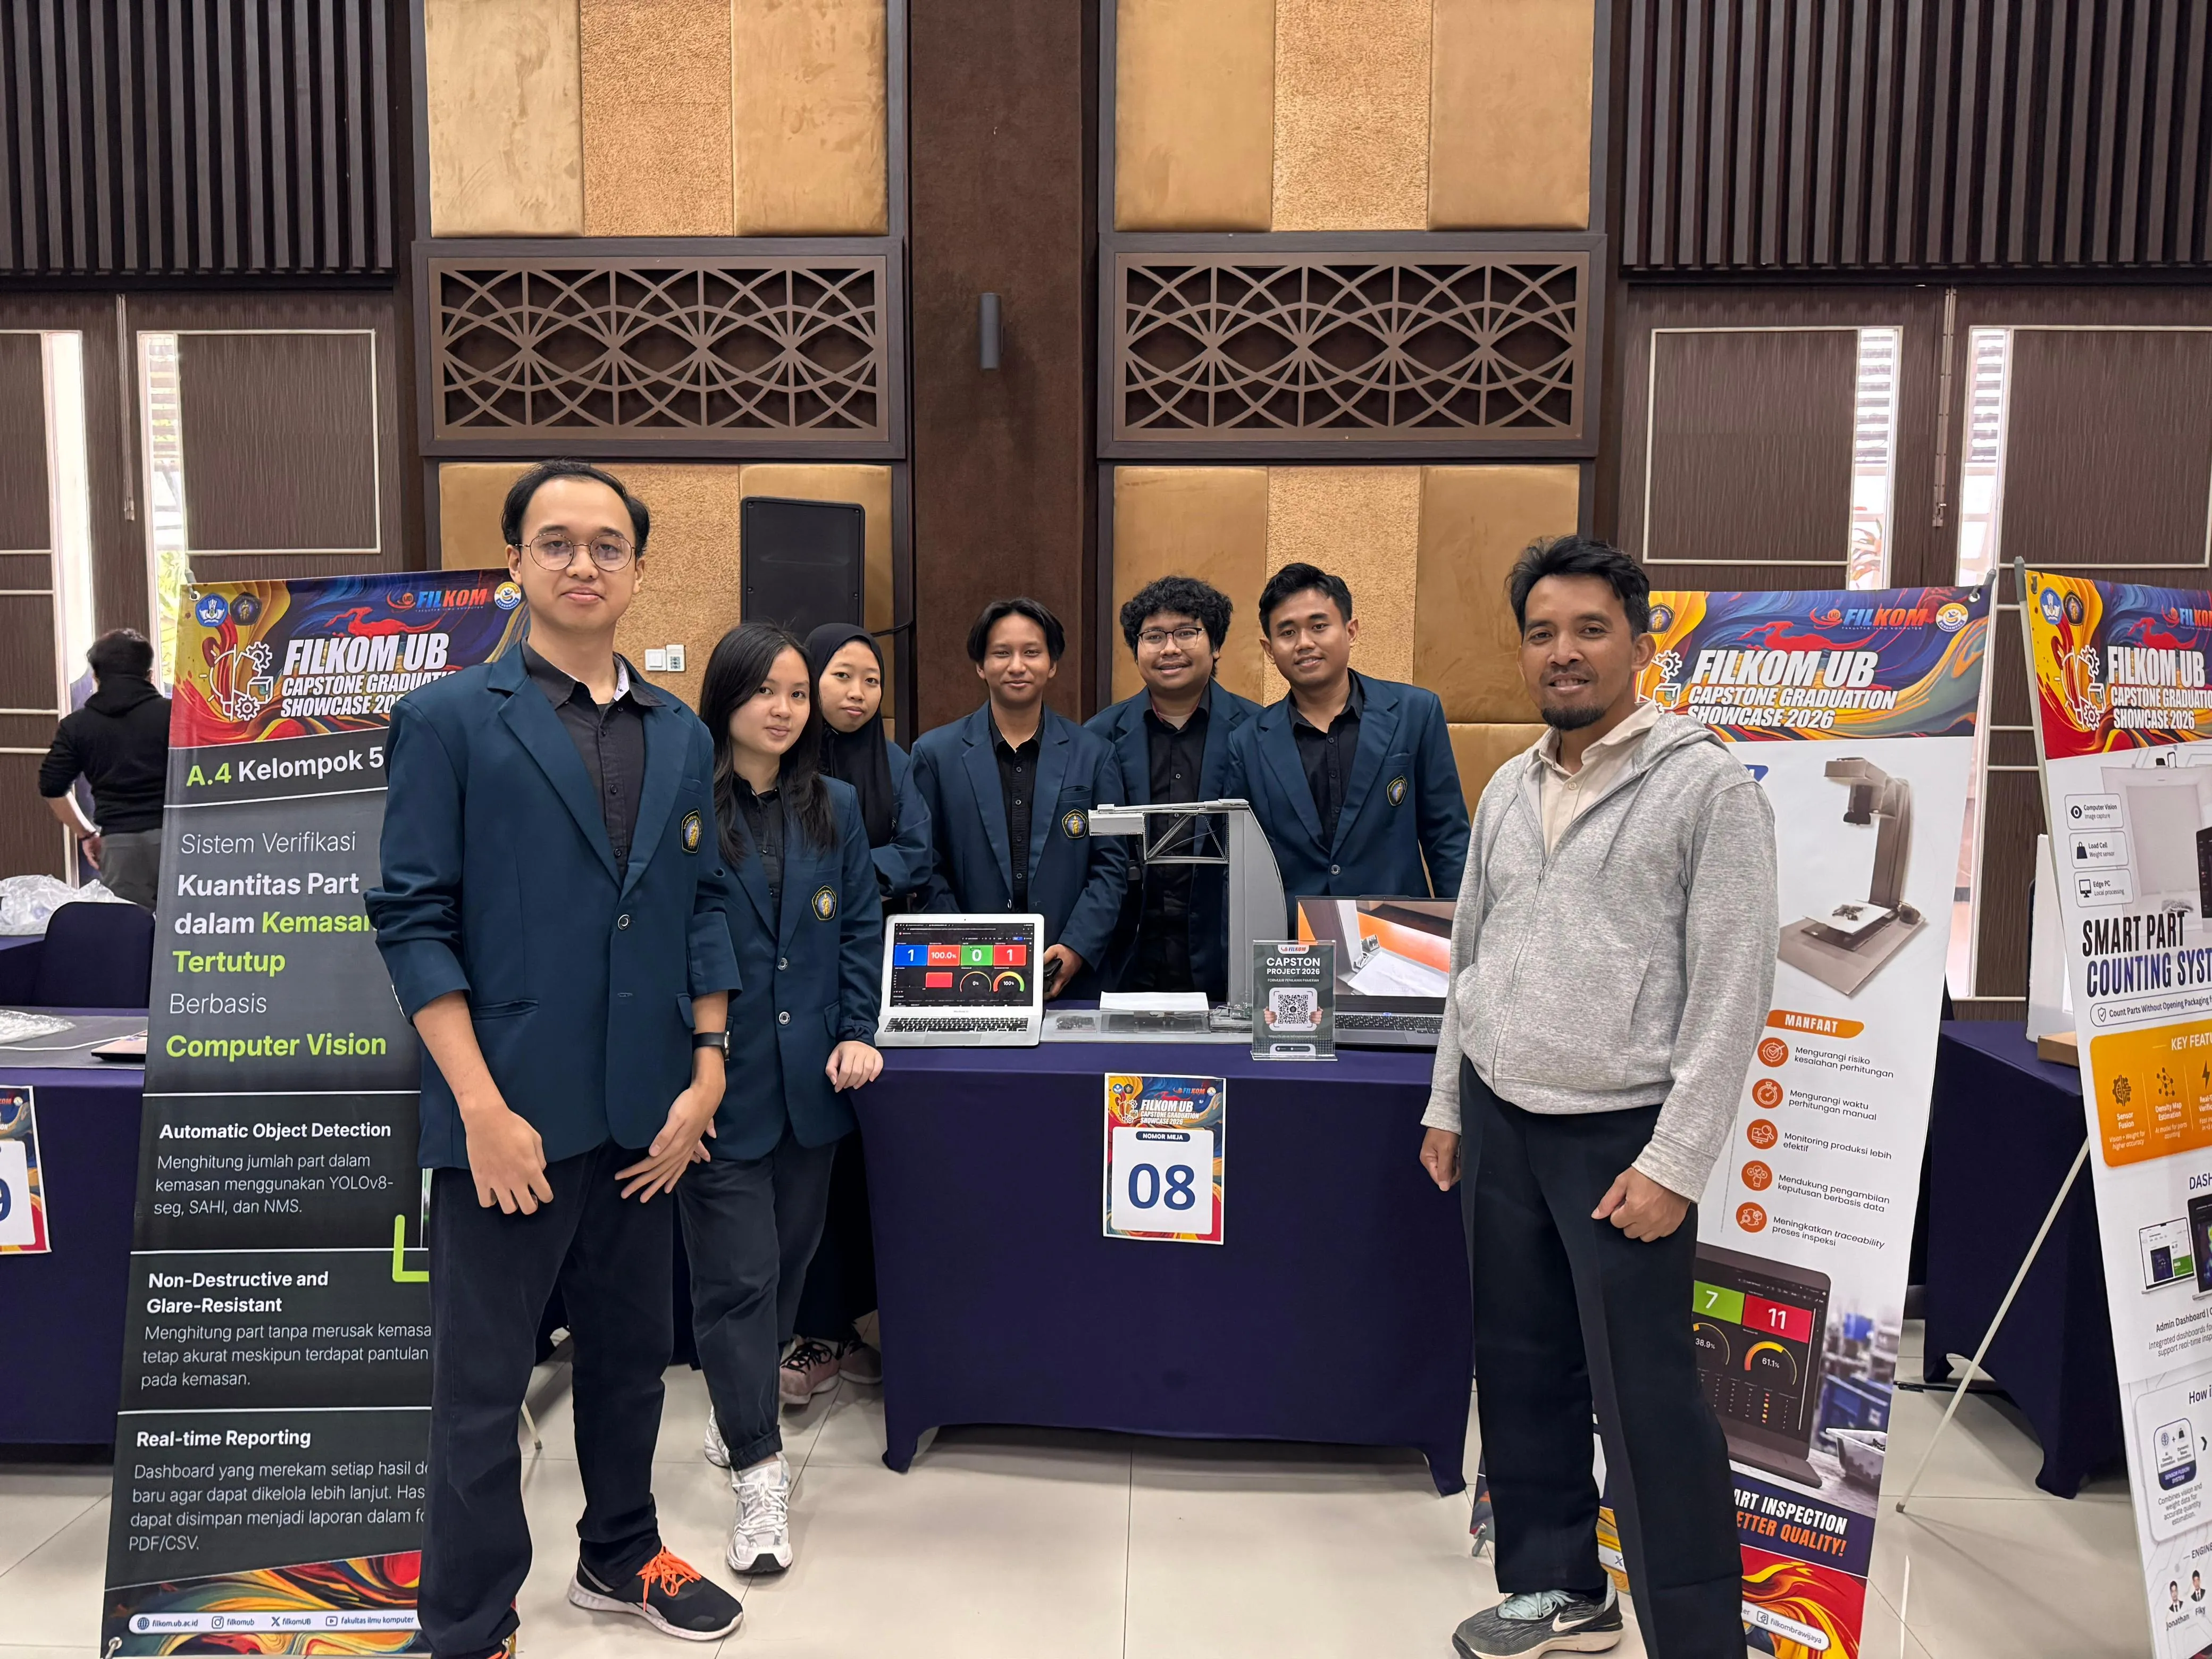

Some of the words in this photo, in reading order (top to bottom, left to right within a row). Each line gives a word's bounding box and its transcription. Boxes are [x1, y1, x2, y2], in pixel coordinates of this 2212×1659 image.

[416, 589, 488, 608] FILKOM
[1843, 608, 1928, 626] FILKOM
[283, 635, 399, 675] FILKOM
[402, 633, 449, 671] UB
[1691, 650, 1822, 686] FILKOM
[1824, 651, 1878, 688] UB
[2108, 646, 2176, 686] FILKOM
[2180, 651, 2205, 688] UB
[282, 674, 364, 697] CAPSTONE
[281, 697, 373, 717] SHOWCASE
[1688, 686, 1777, 706] CAPSTONE
[1779, 688, 1897, 709] GRADUATION
[2110, 686, 2161, 707] CAPSTONE
[1688, 706, 1784, 727] SHOWCASE
[1784, 709, 1836, 728] 2026
[2114, 708, 2169, 730] SHOWCASE
[2169, 710, 2194, 730] 2026
[186, 763, 231, 787] A.4
[239, 749, 363, 782] Kelompok
[369, 747, 384, 768] 5
[181, 834, 254, 853] Sistem
[263, 832, 355, 852] Verifikasi
[178, 874, 300, 896] Kuantitas
[308, 873, 359, 894] Part
[175, 913, 254, 934] dalam
[2082, 916, 2141, 957] SMART
[2147, 912, 2185, 950] PART
[173, 951, 285, 977] Tertutup
[908, 949, 914, 961] 1
[972, 949, 982, 962] 0
[1007, 949, 1013, 961] 1
[1267, 957, 1320, 966] CAPSTON
[2087, 952, 2171, 998] COUNTING
[2177, 948, 2212, 985] SYST
[170, 993, 266, 1013] Berbasis
[2141, 1003, 2162, 1013] Without
[2163, 1001, 2184, 1011] Opening
[2184, 996, 2208, 1007] Packaging
[1785, 1015, 1838, 1033] MANFAAT
[166, 1035, 299, 1061] Computer
[307, 1033, 386, 1055] Vision
[2171, 1036, 2188, 1051] KEY
[1796, 1046, 1846, 1062] Mengurangi
[1848, 1053, 1870, 1064] risiko
[1795, 1055, 1837, 1068] kesalahan
[1840, 1062, 1893, 1078] perhitungan
[1141, 1100, 1179, 1111] FILKOM
[1179, 1101, 1194, 1112] UB
[1789, 1099, 1840, 1115] perhitungan
[1843, 1108, 1876, 1120] manual
[1790, 1090, 1840, 1105] Mengurangi
[1843, 1099, 1869, 1110] waktu
[2155, 1103, 2172, 1113] Density
[2118, 1121, 2134, 1129] Fusion
[2158, 1111, 2181, 1121] Estimation
[160, 1123, 248, 1139] Automatic
[253, 1122, 307, 1141] Object
[312, 1122, 391, 1137] Detection
[1783, 1141, 1808, 1152] efektif
[1784, 1133, 1829, 1149] Monitoring
[1831, 1141, 1868, 1155] produksi
[1870, 1148, 1891, 1159] lebih
[157, 1155, 242, 1172] Menghitung
[246, 1155, 293, 1171] jumlah
[298, 1154, 324, 1170] part
[329, 1154, 370, 1167] dalam
[155, 1179, 219, 1192] kemasan
[225, 1177, 324, 1193] menggunakan
[329, 1176, 393, 1189] YOLOv8-
[1128, 1163, 1195, 1210] 08
[1779, 1175, 1828, 1192] Mendukung
[1830, 1184, 1890, 1204] pengambilan
[154, 1202, 185, 1217] seg,
[189, 1200, 228, 1216] SAHI,
[233, 1200, 259, 1213] dan
[264, 1199, 302, 1213] NMS.
[1778, 1183, 1822, 1199] keputusan
[1824, 1192, 1861, 1208] berbasis
[1863, 1201, 1885, 1212] data
[1772, 1226, 1800, 1239] proses
[1802, 1231, 1836, 1246] inspeksi
[1773, 1216, 1832, 1237] Meningkatkan
[1834, 1229, 1885, 1249] traceability
[148, 1271, 292, 1288] Non-Destructive
[297, 1271, 328, 1286] and
[147, 1297, 282, 1313] Glare-Resistant
[1706, 1290, 1718, 1309] 7
[1768, 1308, 1787, 1329] 11
[2156, 1319, 2175, 1333] Admin
[2176, 1309, 2206, 1326] Dashboard
[2149, 1334, 2175, 1350] Integrated
[2176, 1325, 2206, 1341] dashboards
[2158, 1344, 2178, 1356] support
[2179, 1337, 2201, 1350] real-time
[1695, 1338, 1715, 1350] 38.9%
[1762, 1358, 1780, 1369] 61.1%
[2189, 1389, 2207, 1404] How
[137, 1431, 221, 1447] Real-time
[226, 1429, 311, 1448] Reporting
[135, 1464, 214, 1479] Dashboard
[219, 1465, 254, 1481] yang
[259, 1463, 326, 1478] merekam
[331, 1462, 373, 1478] setiap
[379, 1461, 410, 1476] hasil
[1761, 1496, 1848, 1535] INSPECTION
[129, 1535, 199, 1552] PDF/CSV.
[1780, 1524, 1847, 1557] QUALITY!
[1771, 1619, 1821, 1644] filkombrawijaya
[2166, 1614, 2190, 1631] Jonathan
